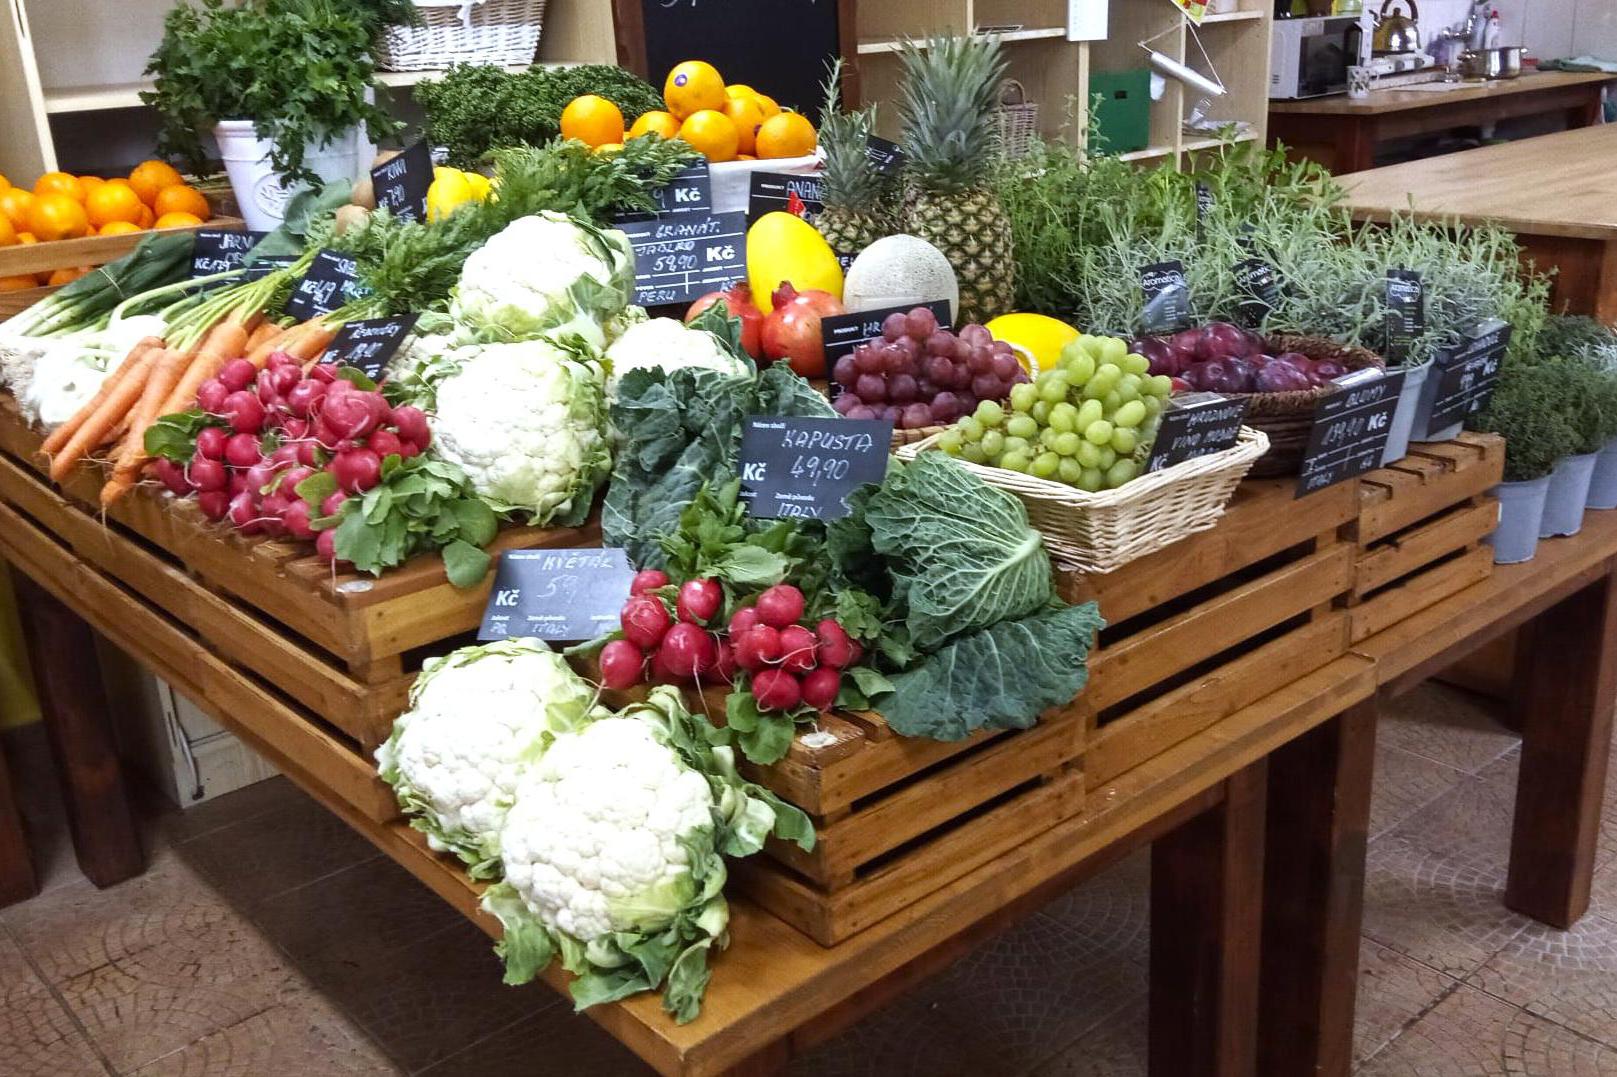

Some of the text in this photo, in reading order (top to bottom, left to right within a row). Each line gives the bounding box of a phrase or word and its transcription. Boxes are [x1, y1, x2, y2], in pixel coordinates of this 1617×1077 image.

[674, 187, 702, 203] Kč
[787, 180, 822, 201] ANAN
[218, 233, 254, 250] JARN
[706, 245, 737, 262] Kč
[1366, 410, 1388, 432] Kč
[781, 429, 873, 453] KAPUSTA
[742, 462, 767, 482] Kč
[789, 455, 849, 487] 49,90
[494, 588, 521, 607] Kč
